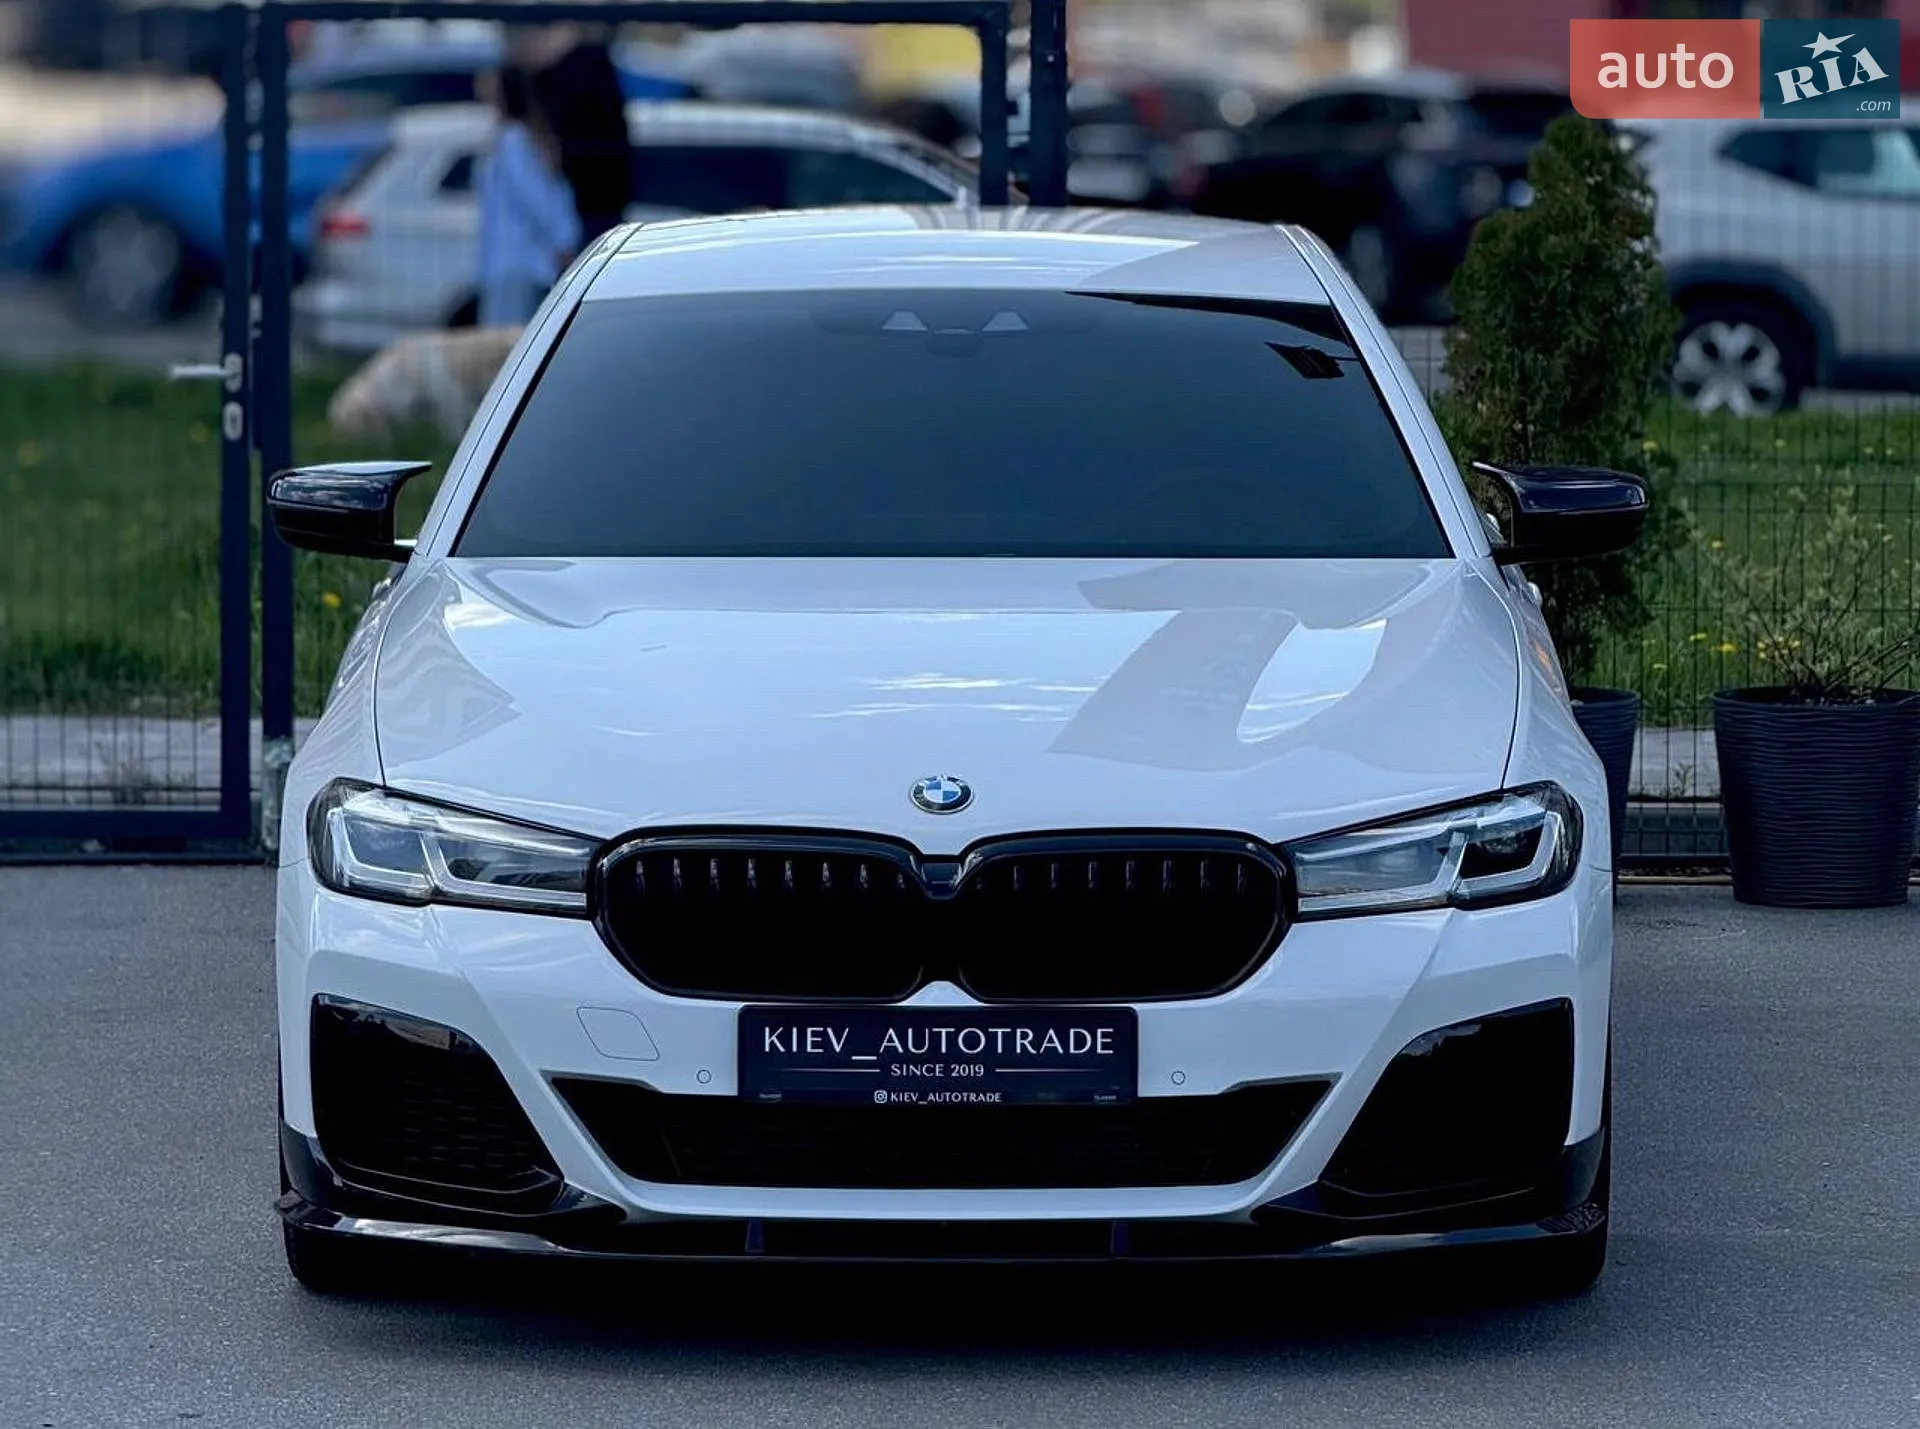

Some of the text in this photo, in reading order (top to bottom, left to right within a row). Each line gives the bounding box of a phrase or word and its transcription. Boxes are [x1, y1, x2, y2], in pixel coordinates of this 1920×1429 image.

[764, 1026, 1115, 1060] KIEV_AUTOTRADE
[890, 1063, 985, 1077] SINCE 2019
[890, 1091, 1002, 1105] KIEV_AUTOTRADE
